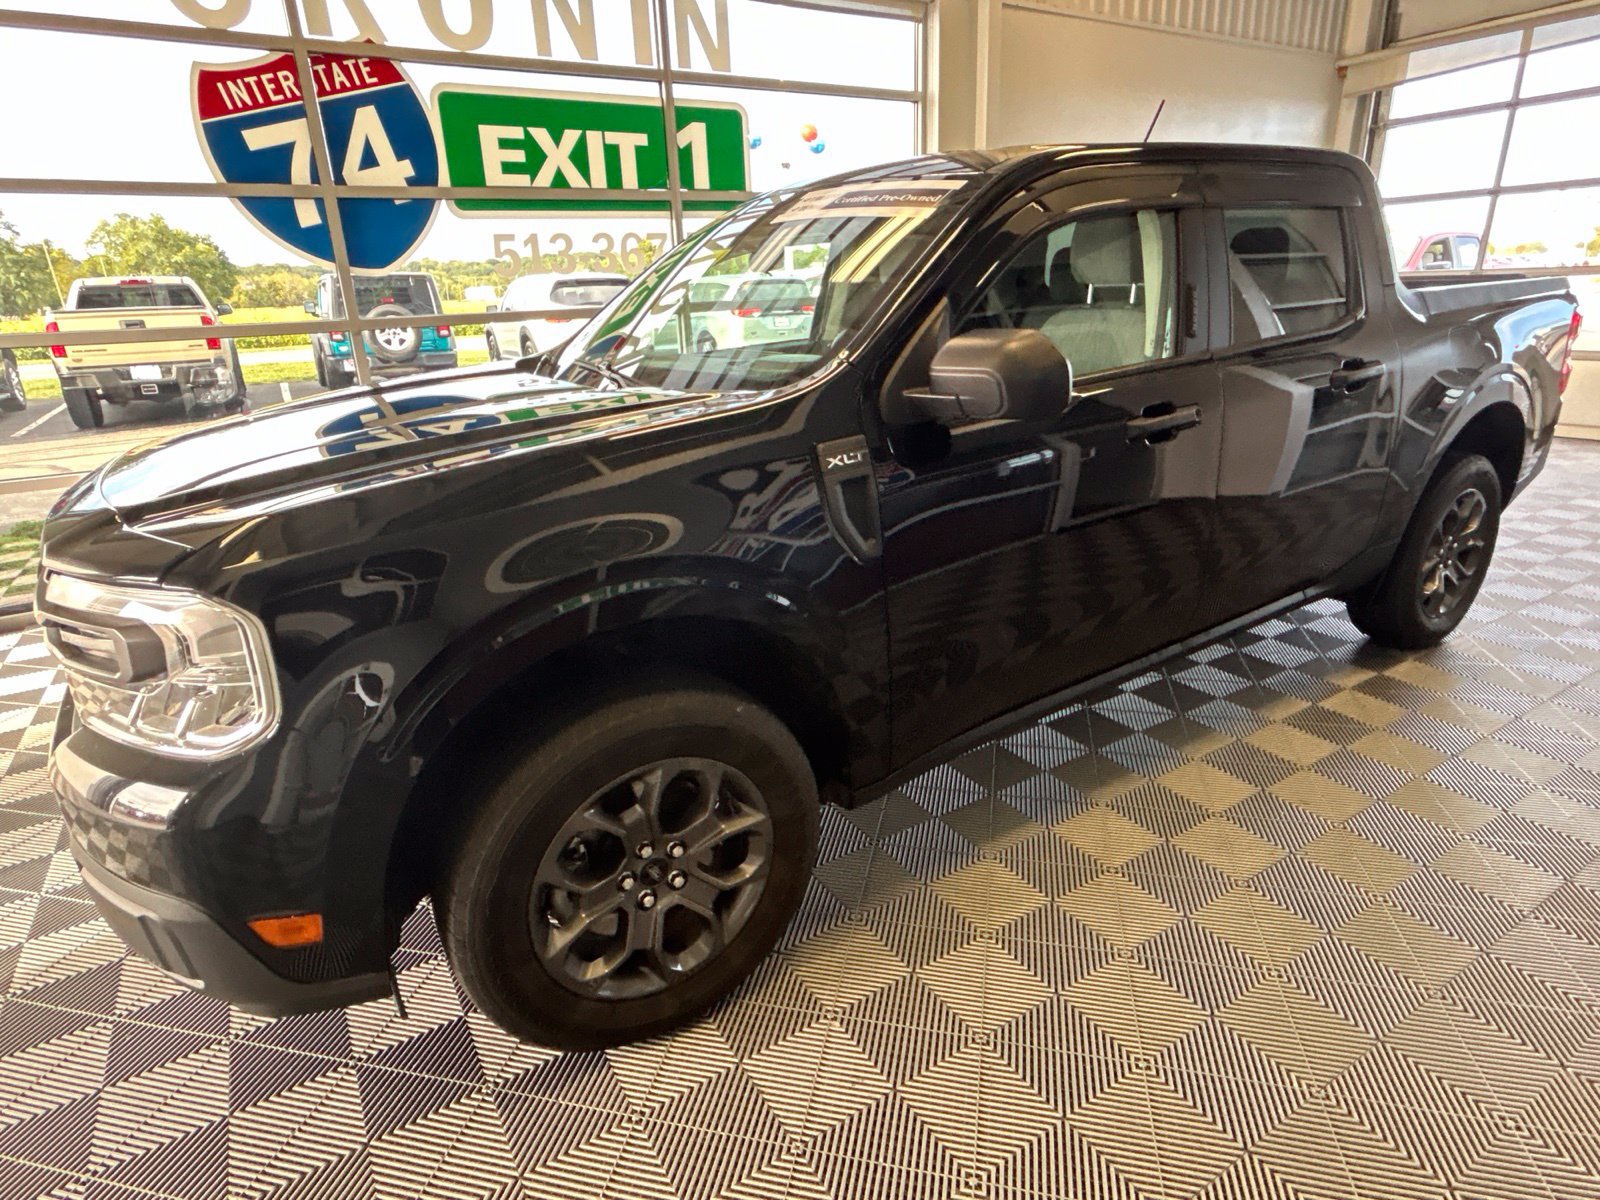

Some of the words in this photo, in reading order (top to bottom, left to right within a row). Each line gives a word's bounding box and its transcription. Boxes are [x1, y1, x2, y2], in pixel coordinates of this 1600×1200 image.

[170, 0, 731, 72] ONIN
[217, 58, 379, 110] INTERTATE
[241, 105, 415, 228] 74
[478, 124, 648, 189] EXIT
[676, 121, 710, 190] 1
[493, 231, 697, 277] 513-367
[826, 450, 868, 469] XLT
